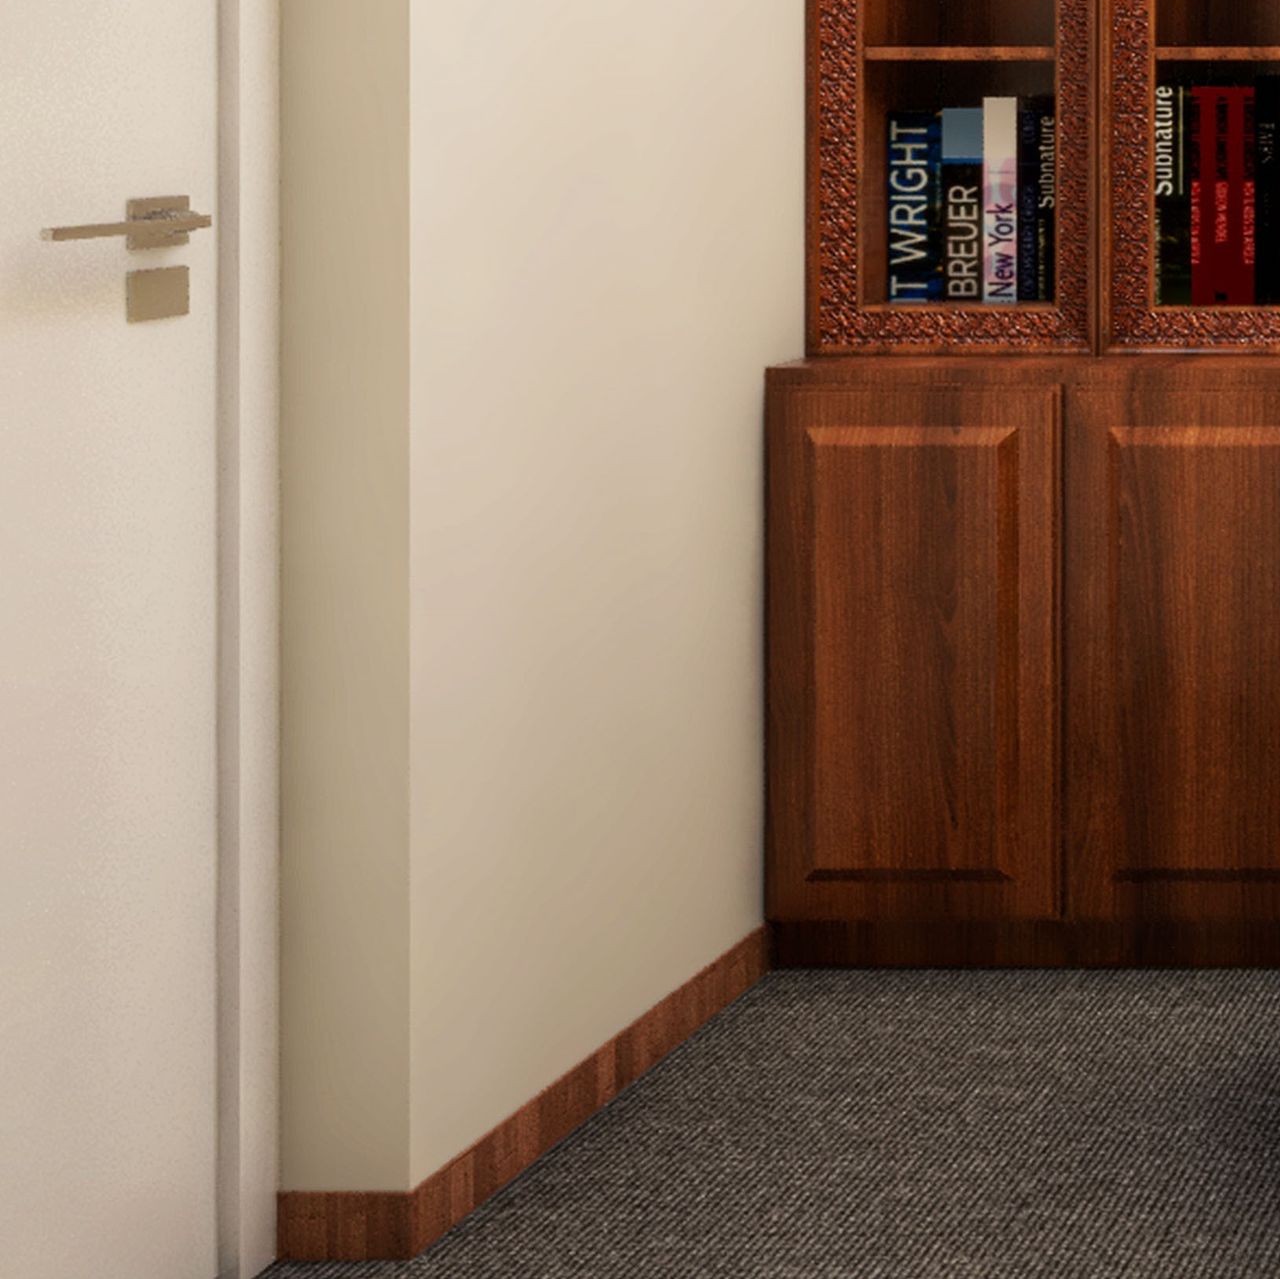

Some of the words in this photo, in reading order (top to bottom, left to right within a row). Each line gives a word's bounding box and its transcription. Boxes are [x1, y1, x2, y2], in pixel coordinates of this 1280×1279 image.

[1038, 116, 1055, 208] Subnature
[1155, 86, 1173, 196] Subnature
[890, 120, 928, 265] WRIGHT
[948, 185, 978, 297] BREUER
[986, 203, 1013, 247] York
[988, 252, 1013, 297] New
